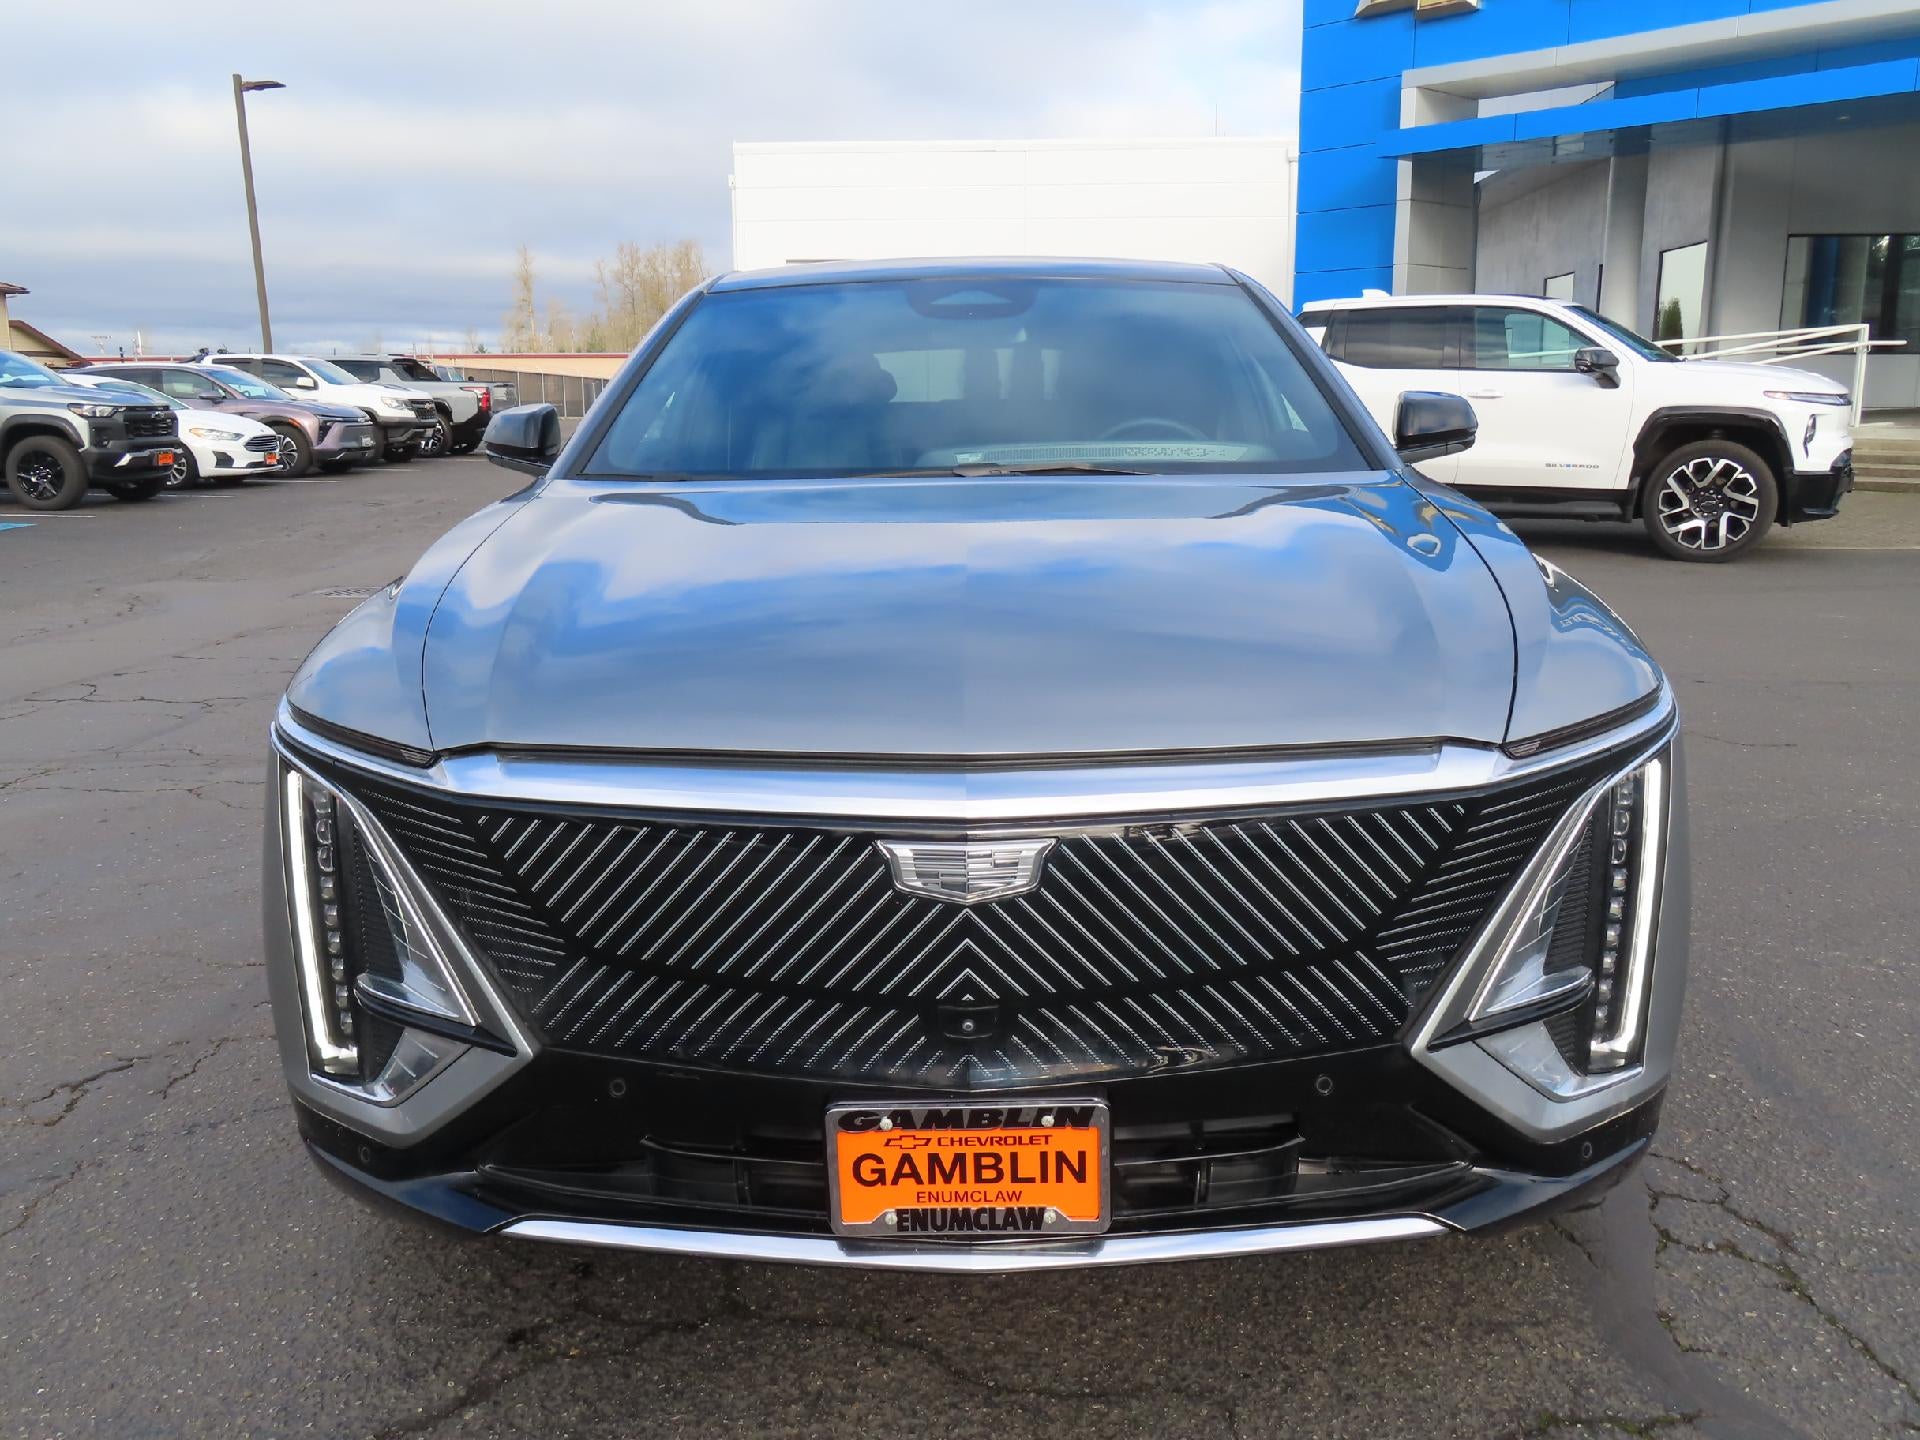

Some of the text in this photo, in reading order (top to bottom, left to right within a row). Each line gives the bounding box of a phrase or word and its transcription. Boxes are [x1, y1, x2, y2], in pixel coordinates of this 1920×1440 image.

[937, 1134, 1053, 1146] CHEVROLET
[852, 1150, 1087, 1187] GAMBLIN
[916, 1190, 1023, 1203] ENUMCLAW
[896, 1207, 1047, 1232] ENUMCLAW
